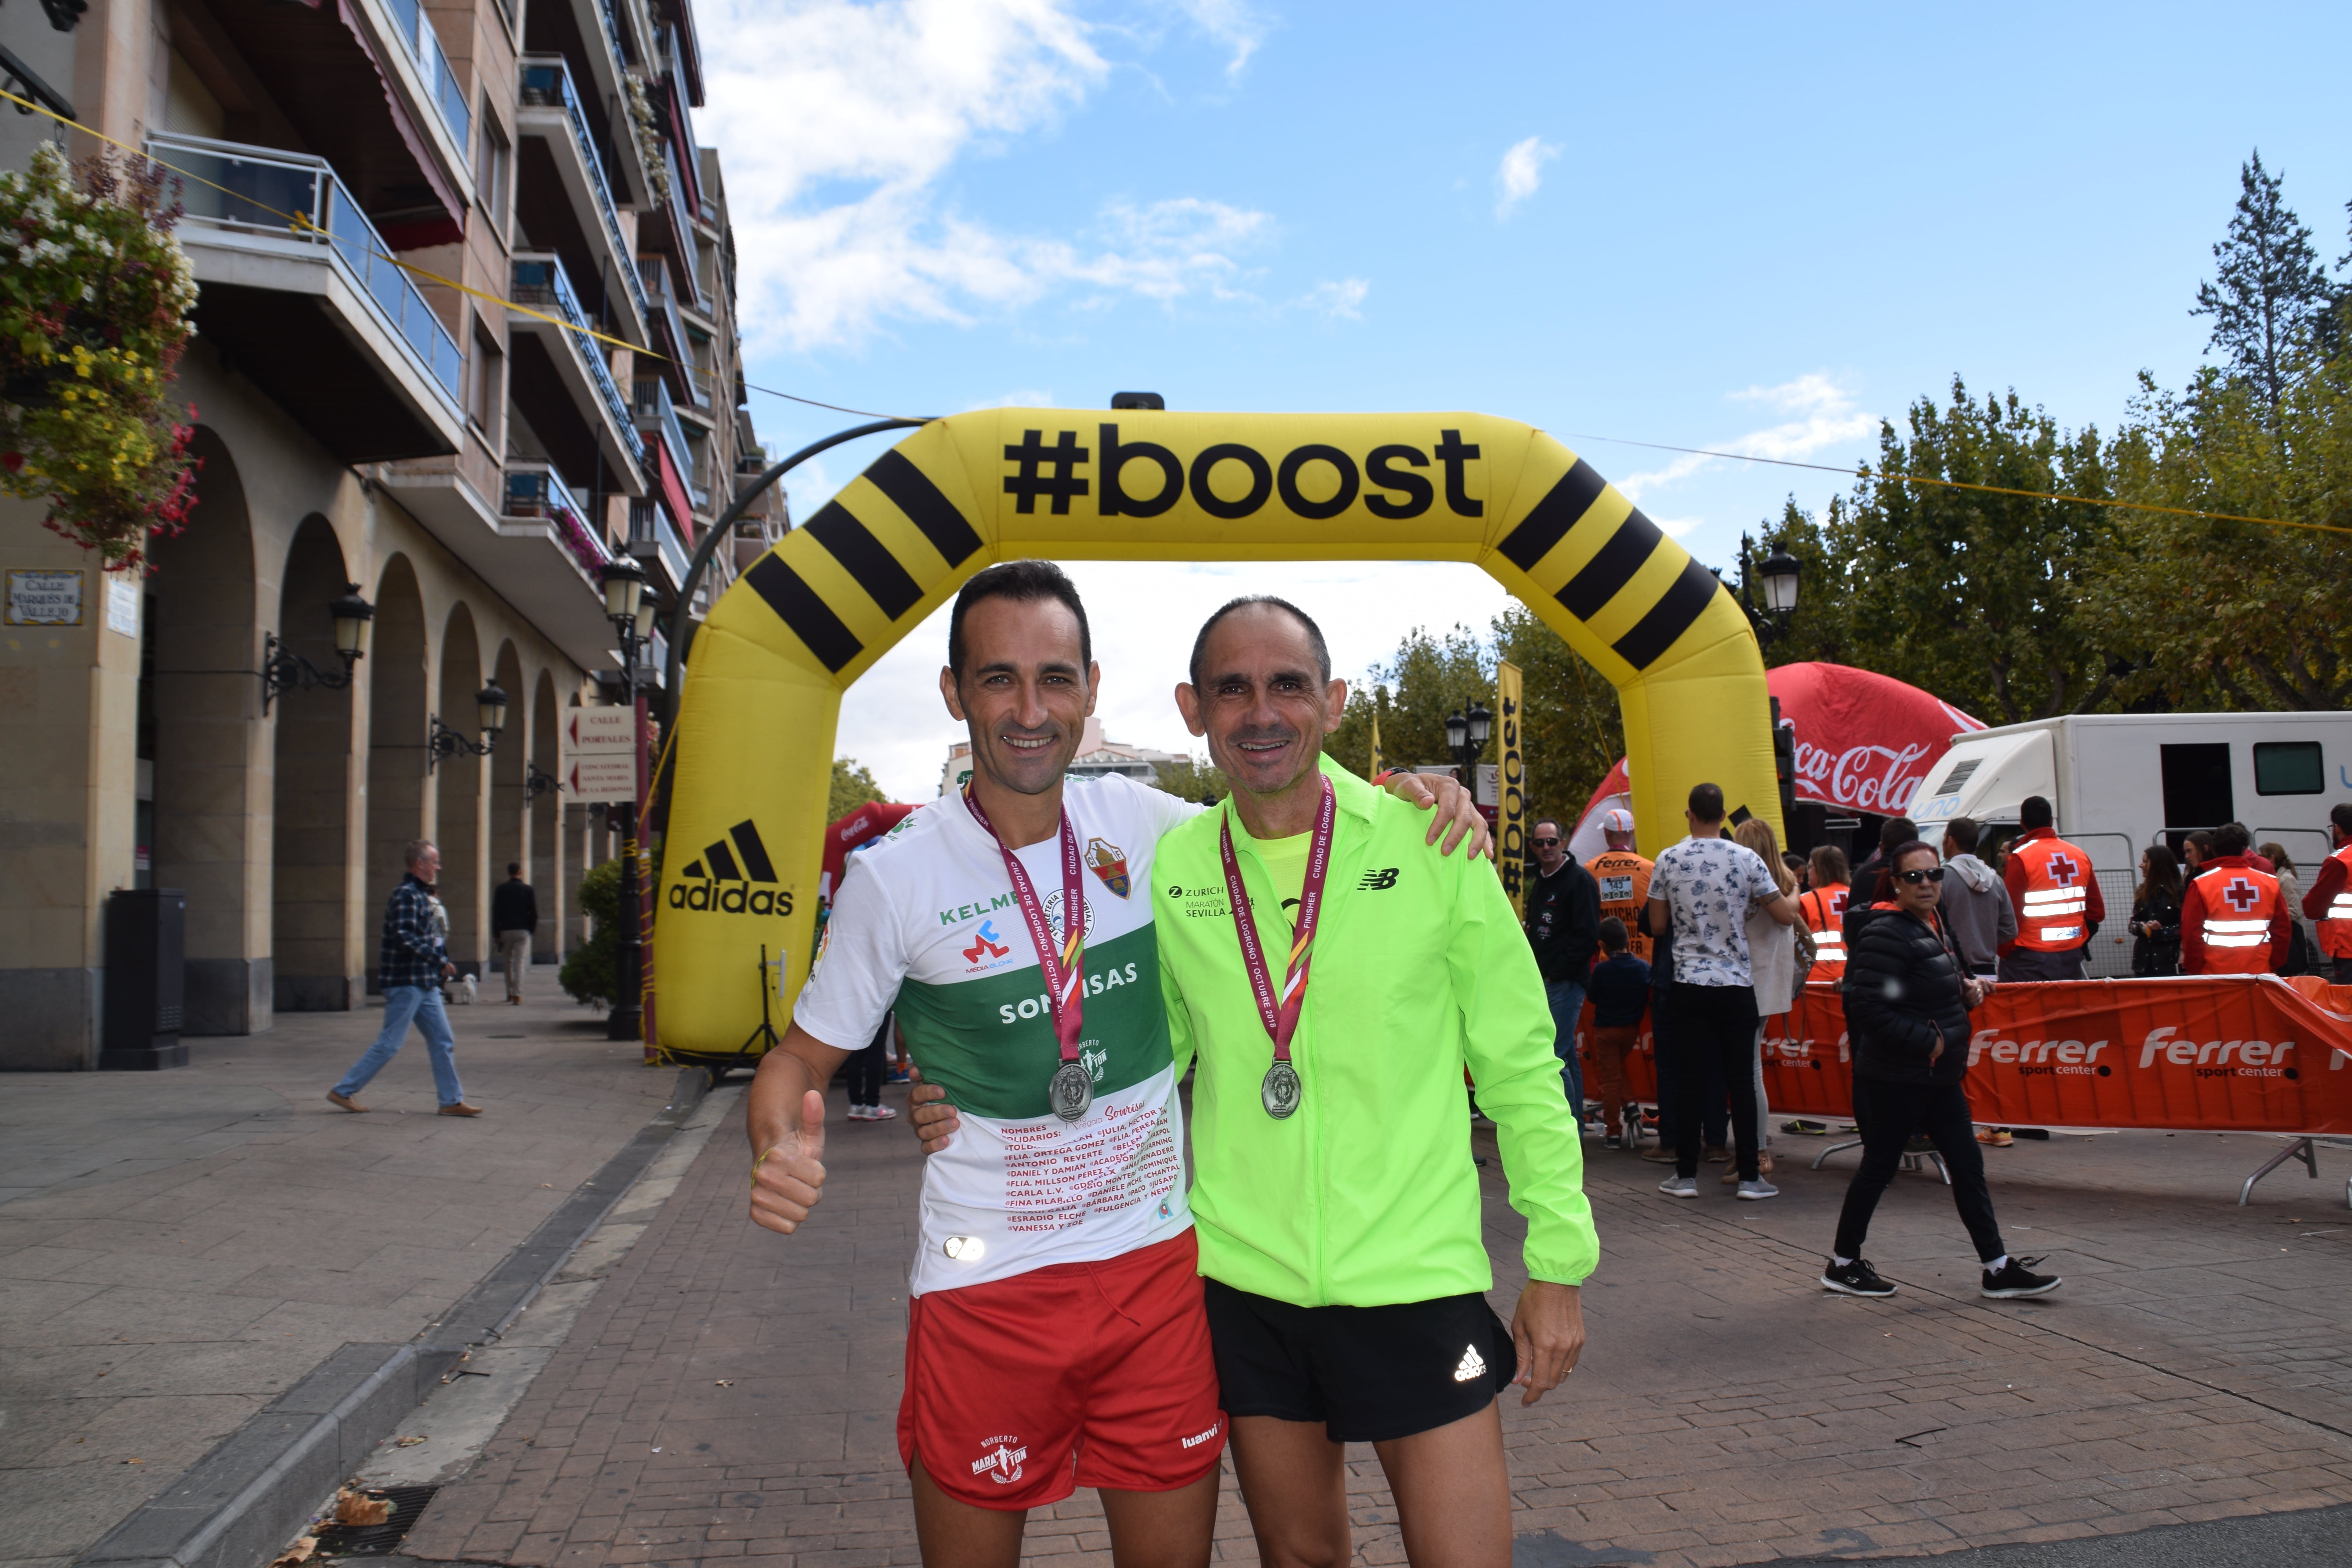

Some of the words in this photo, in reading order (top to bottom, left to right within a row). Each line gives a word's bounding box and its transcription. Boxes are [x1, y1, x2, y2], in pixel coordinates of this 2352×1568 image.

[1004, 423, 1484, 520] #boost
[25, 579, 64, 590] CALLE
[64, 594, 74, 603] DE
[18, 606, 68, 618] VALLEJO
[590, 716, 621, 724] CALLE
[582, 735, 630, 744] PORTALES
[967, 798, 989, 827] FINISHER
[1321, 795, 1332, 834] LOGROÑO
[1067, 833, 1074, 844] DE
[1221, 829, 1231, 864] FINISHER
[1318, 835, 1327, 847] DE
[1068, 845, 1076, 875] CIUDAD
[1313, 848, 1324, 879] CIUDAD
[1011, 862, 1028, 893] CIUDAD
[1609, 882, 1623, 890] 143
[669, 877, 794, 917] adidas
[1024, 894, 1034, 907] DE
[1185, 886, 1224, 897] ZURICH
[1230, 875, 1242, 906] CIUDAD
[1186, 898, 1224, 908] MARATÓN
[1186, 908, 1226, 918] SEVILLA
[1237, 906, 1246, 918] DE
[1303, 891, 1316, 929] FINISHER
[1028, 907, 1049, 951] LOGROÑO
[1240, 919, 1257, 960] LOGROÑO
[965, 965, 989, 974] MEDIA
[989, 958, 1014, 969] ELCHE
[1047, 960, 1062, 1003] OCTUBRE
[1253, 967, 1271, 1008] OCTUBRE
[999, 962, 1138, 1024] SONISAS
[1265, 1009, 1276, 1028] 2018
[1104, 1100, 1145, 1121] Sonrisas
[1001, 1125, 1047, 1134] NOMBRES
[1097, 1124, 1127, 1137] @JULIA,
[1128, 1110, 1157, 1127] HECTOR
[1034, 1147, 1073, 1158] ORTEGA
[1075, 1139, 1105, 1151] GOMEZ
[1132, 1120, 1156, 1135] PEREA
[1005, 1158, 1057, 1167] @ANTONIO
[1063, 1149, 1103, 1163] REVERTE
[1112, 1134, 1143, 1151] @BELEN
[1035, 1175, 1075, 1186] MILLSON
[1078, 1168, 1104, 1180] PEREZ
[1144, 1136, 1172, 1151] LEARNING
[1140, 1146, 1174, 1162] BENADERO
[1052, 1163, 1086, 1174] DAMIAN
[1138, 1154, 1178, 1172] @DOMINIQUE
[1088, 1183, 1125, 1198] @DANIELE
[1127, 1176, 1142, 1189] PICHE
[1144, 1164, 1180, 1179] @CHANTAL
[1127, 1184, 1146, 1196] @PACO
[1007, 1214, 1054, 1223] @ESRADIO
[1058, 1210, 1087, 1220] ELCHE
[1093, 1196, 1142, 1213] @FULGENCIA
[1007, 1223, 1055, 1232] @VANESSA
[1066, 1219, 1084, 1228] ZOE
[980, 1435, 1018, 1448] NORBERTO
[1182, 1423, 1218, 1449] luanvi
